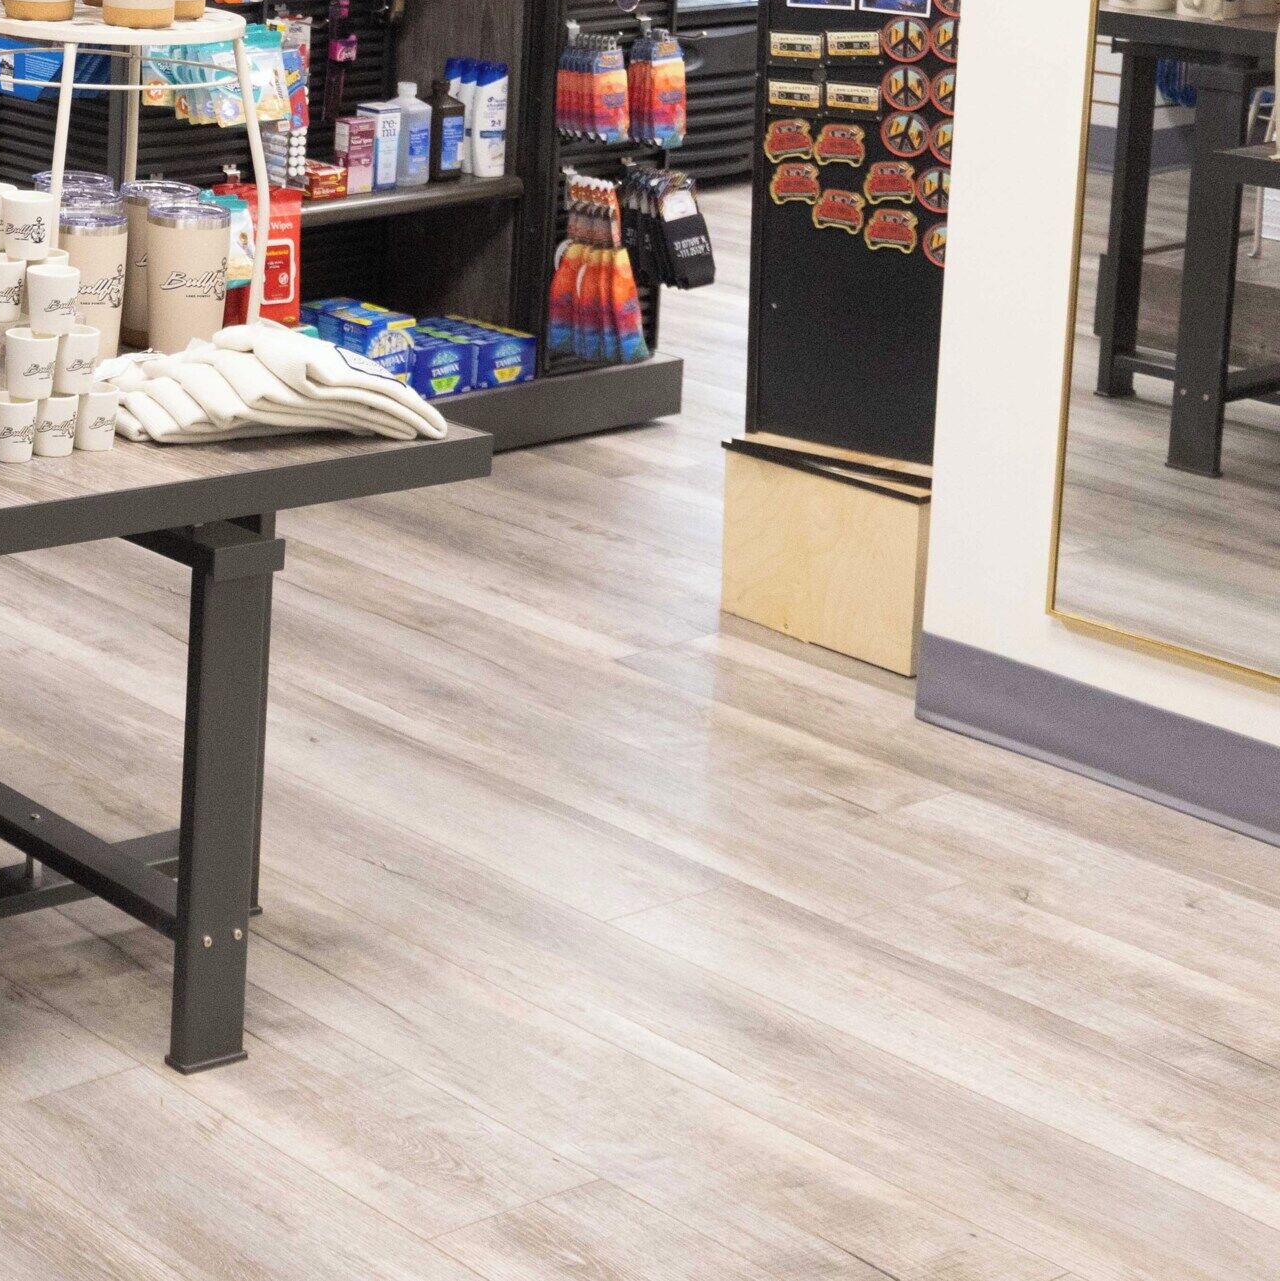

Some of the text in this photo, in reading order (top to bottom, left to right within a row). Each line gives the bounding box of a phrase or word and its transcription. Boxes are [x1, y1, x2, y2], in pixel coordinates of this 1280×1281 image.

[271, 221, 293, 232] Wipes
[495, 355, 523, 369] TAMPAX
[431, 362, 460, 378] TAMPAX
